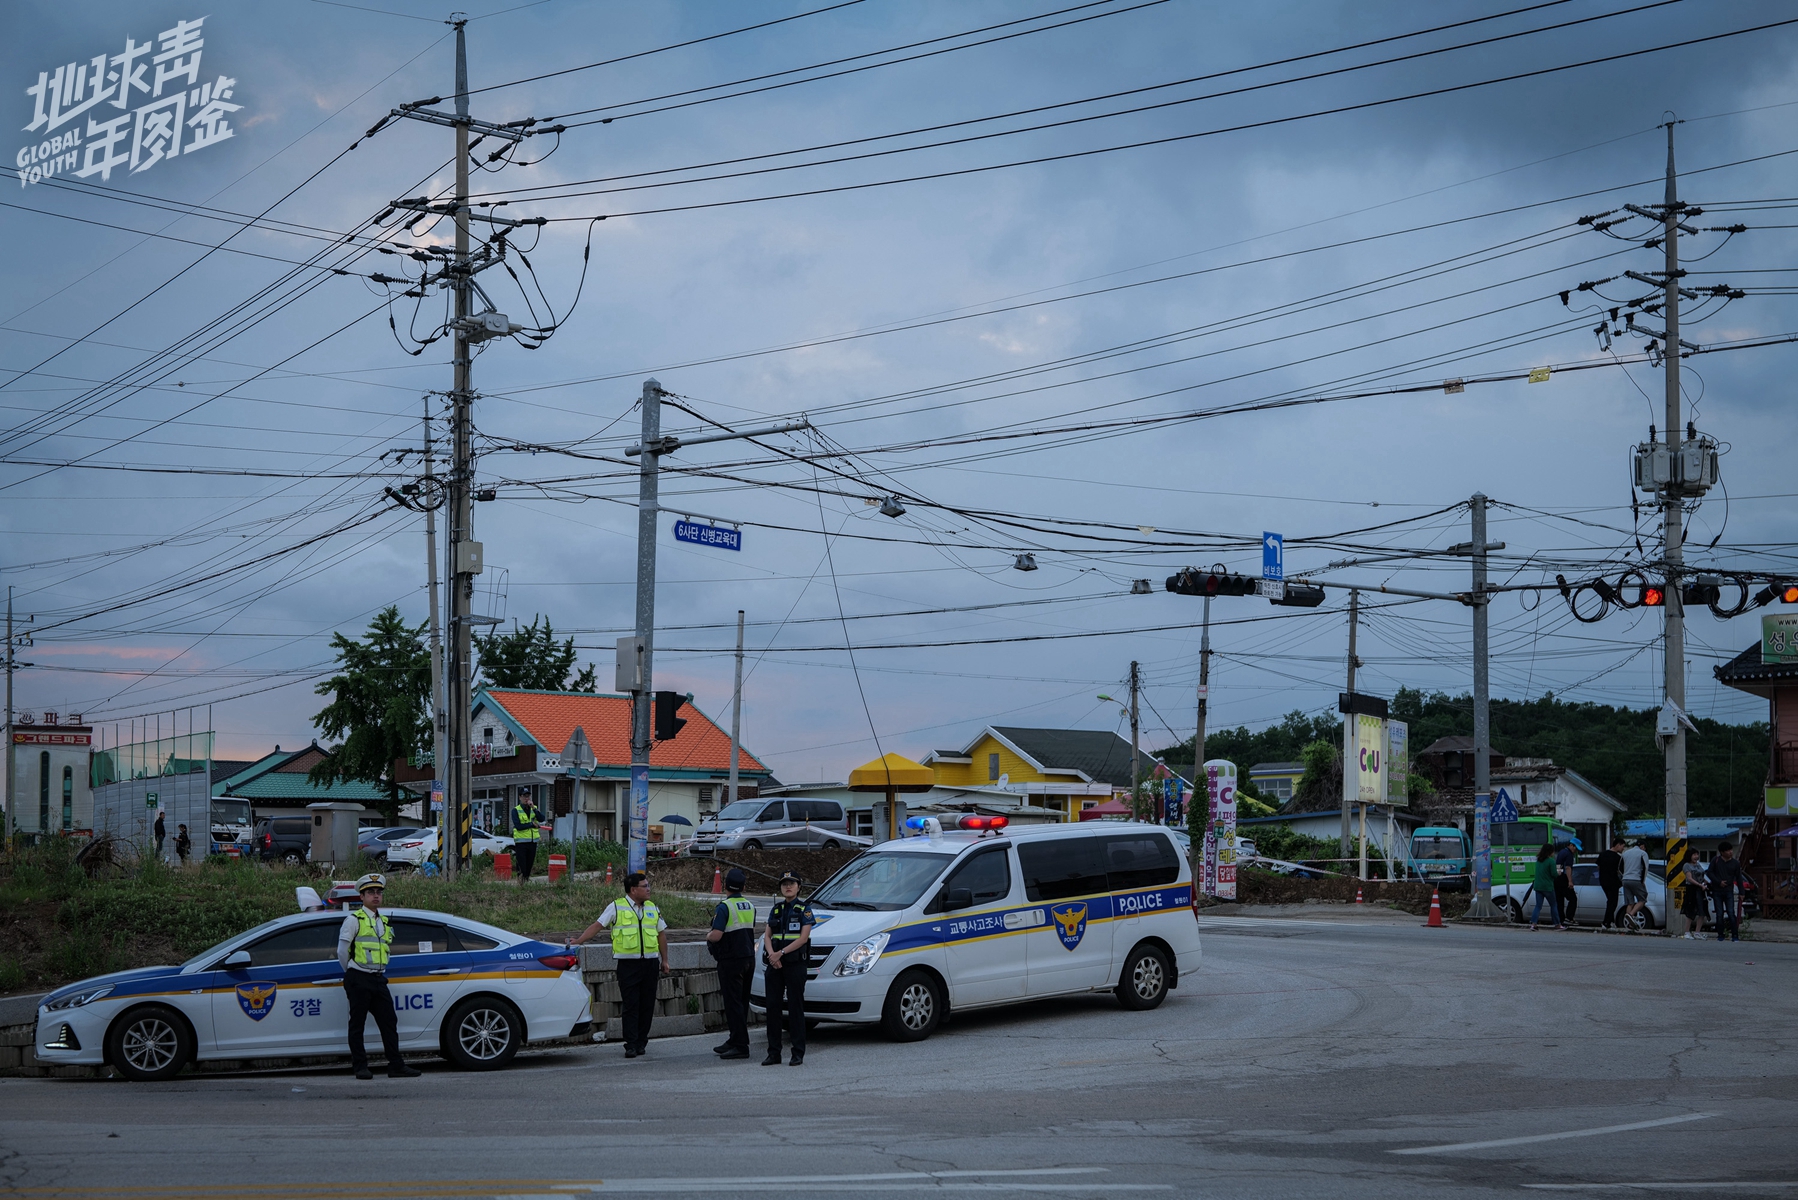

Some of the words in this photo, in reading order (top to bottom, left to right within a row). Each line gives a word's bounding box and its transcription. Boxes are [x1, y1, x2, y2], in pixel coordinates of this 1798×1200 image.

[678, 524, 699, 540] 6사단
[700, 528, 738, 548] 신병교육대
[1263, 564, 1282, 577] 비보호
[1360, 747, 1379, 773] CU
[1366, 786, 1375, 795] OPEN
[1119, 893, 1163, 912] POLICE
[949, 916, 1003, 935] 교통사고조사
[1063, 935, 1079, 943] POLICE
[508, 952, 534, 960] 철원01
[290, 998, 322, 1018] 경찰
[394, 993, 433, 1011] LICE
